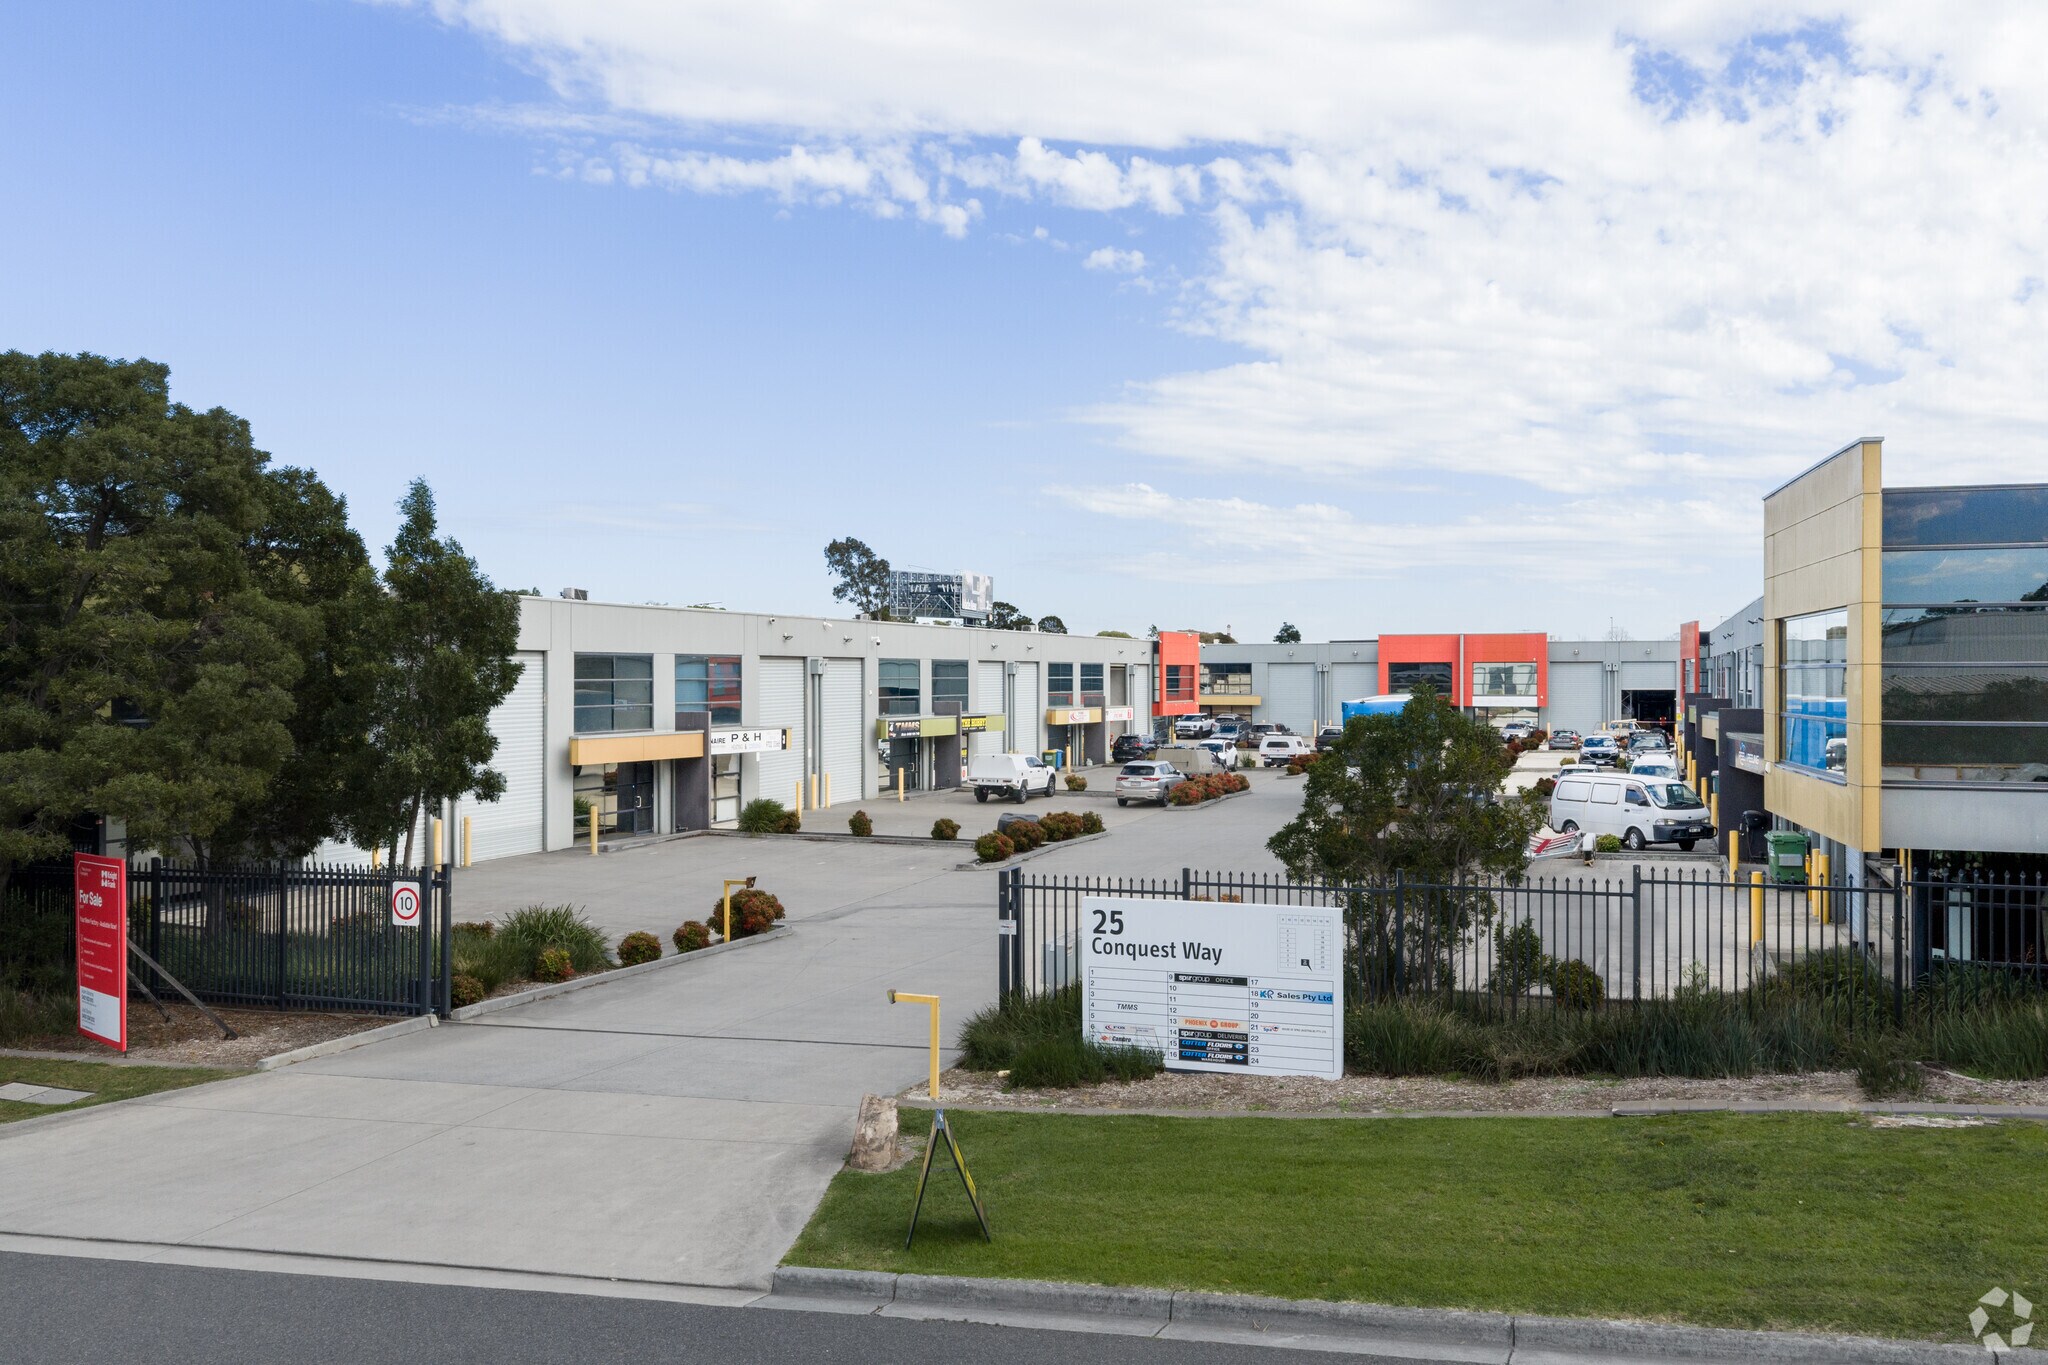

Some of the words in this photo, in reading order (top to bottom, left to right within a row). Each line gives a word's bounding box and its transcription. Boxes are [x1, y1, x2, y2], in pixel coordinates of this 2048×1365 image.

[895, 721, 920, 730] TMMS
[731, 734, 738, 742] P
[742, 733, 750, 742] &
[754, 732, 761, 741] H
[80, 890, 88, 904] For
[89, 892, 102, 907] Sale
[400, 897, 412, 910] 10
[1092, 909, 1124, 935] 25
[1092, 937, 1176, 961] Conquest
[1182, 942, 1222, 966] Way
[1302, 994, 1316, 1002] Pty
